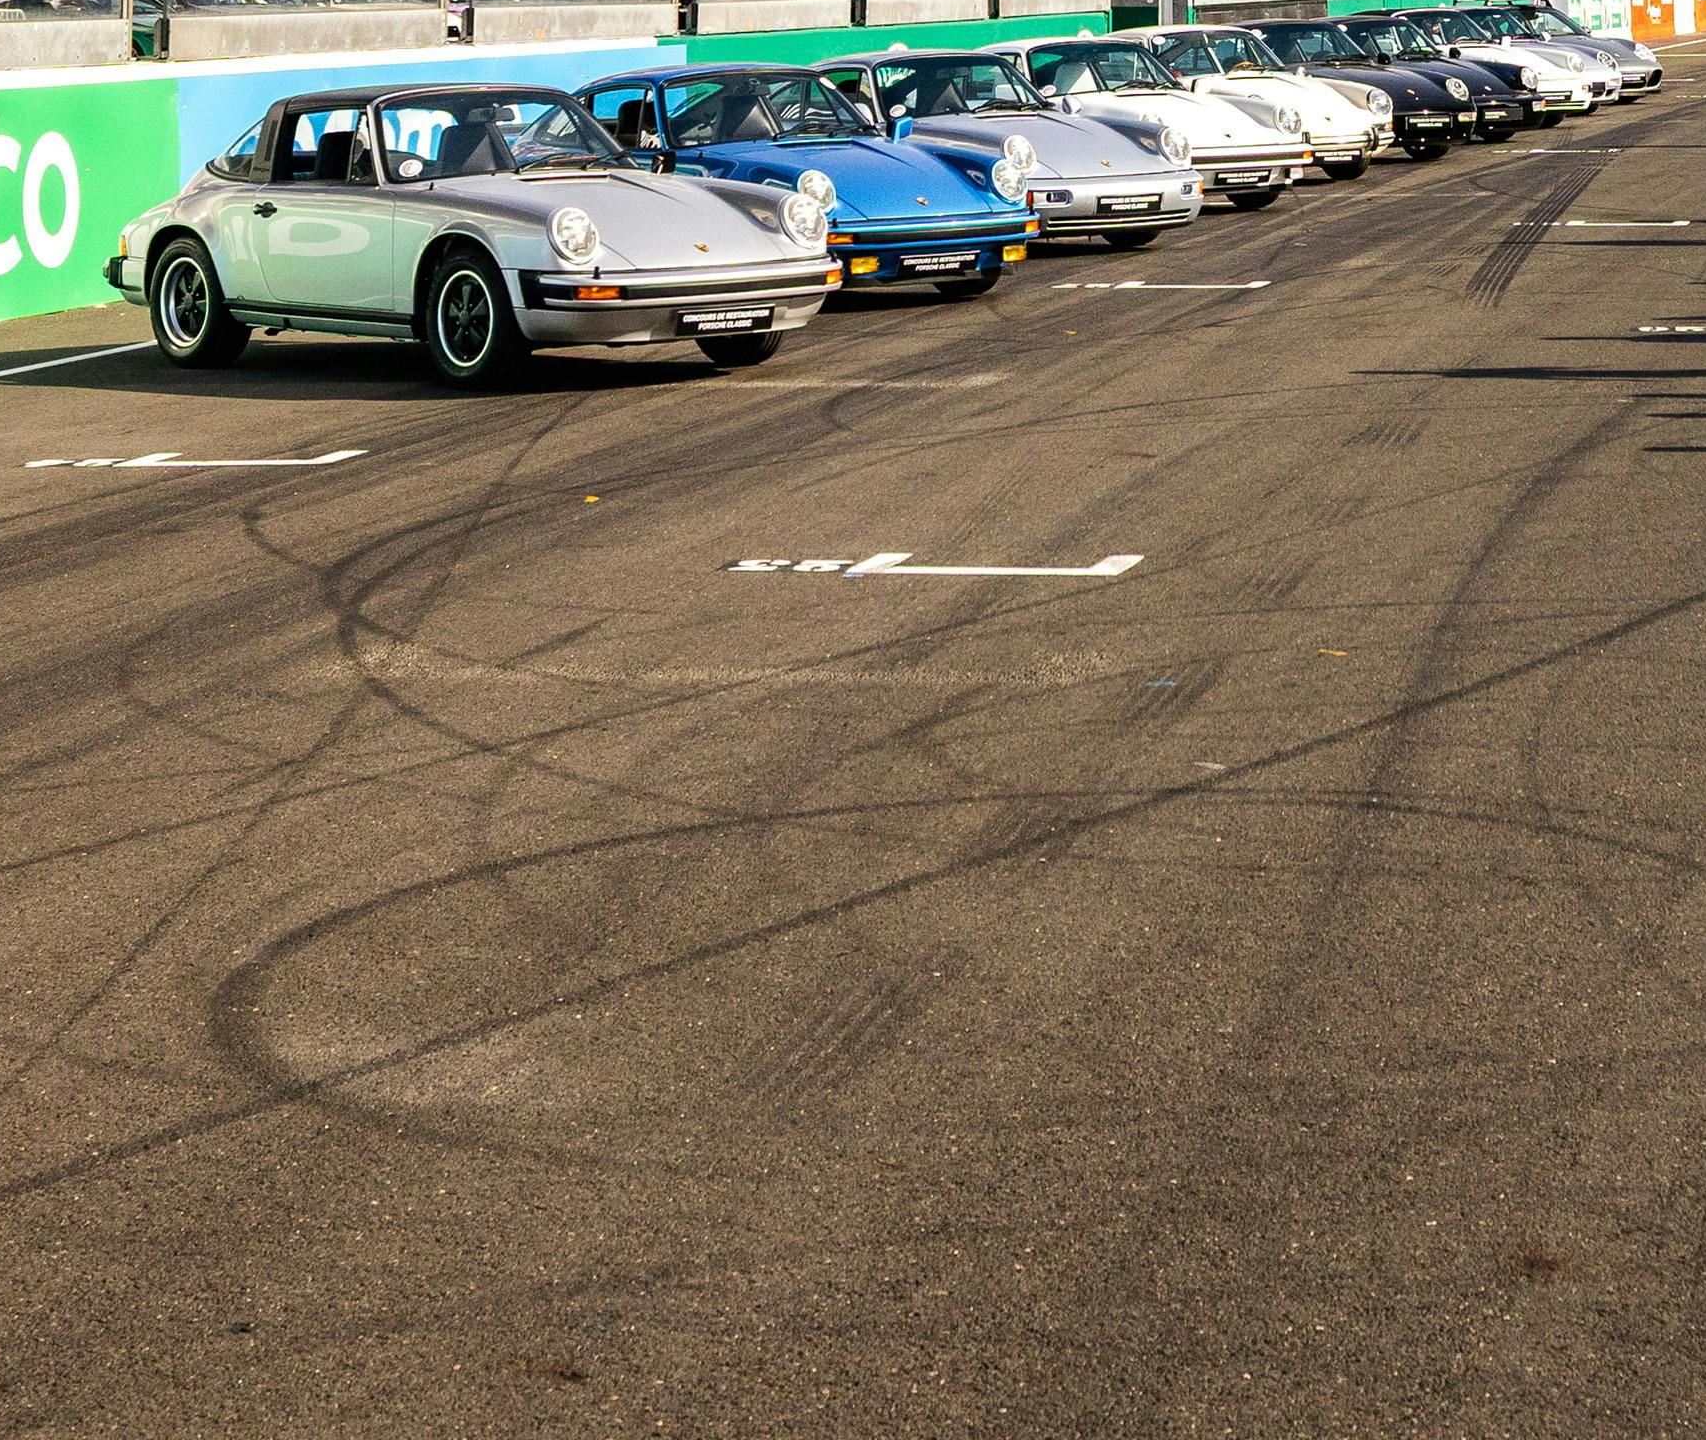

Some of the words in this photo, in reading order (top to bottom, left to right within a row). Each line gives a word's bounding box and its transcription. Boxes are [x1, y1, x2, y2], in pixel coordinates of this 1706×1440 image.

[683, 313, 716, 323] CONCOURS
[717, 312, 725, 320] DE
[726, 309, 770, 319] RESTAURATION
[698, 321, 727, 330] PORSCHE
[727, 319, 752, 328] CLASSIC
